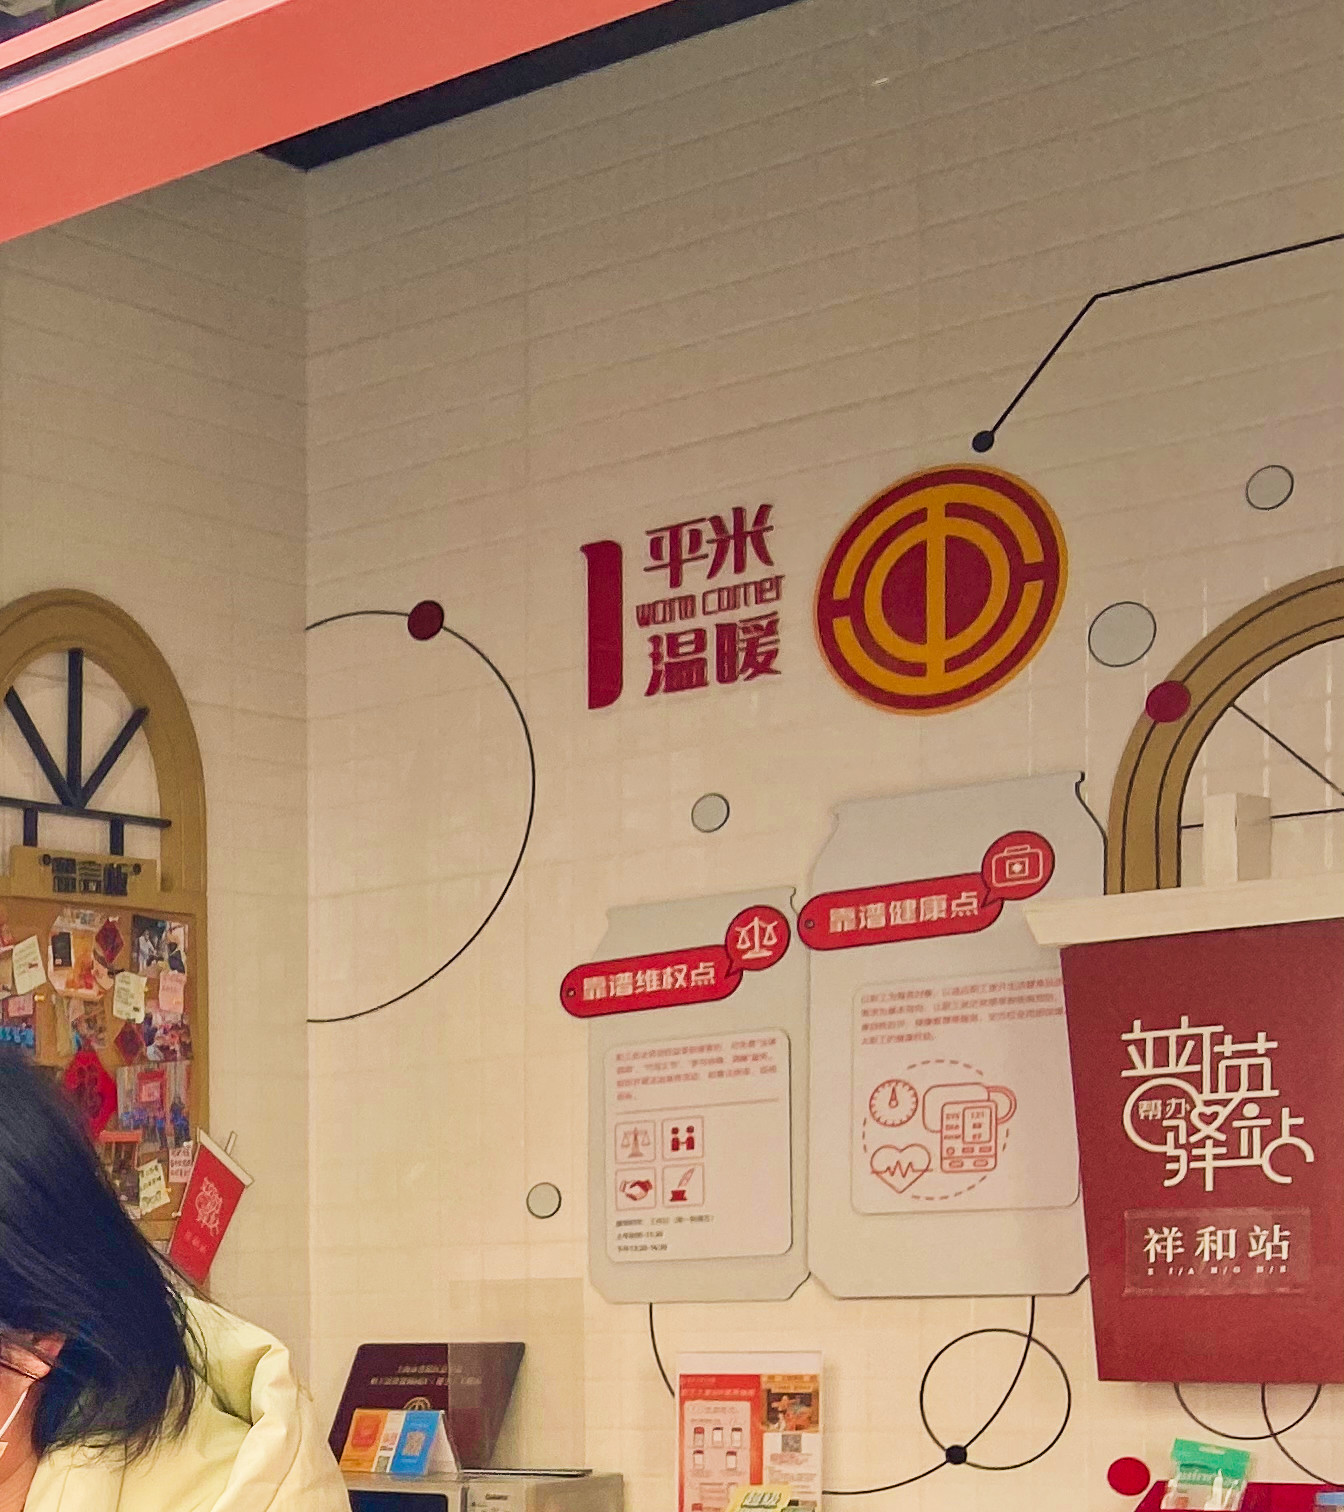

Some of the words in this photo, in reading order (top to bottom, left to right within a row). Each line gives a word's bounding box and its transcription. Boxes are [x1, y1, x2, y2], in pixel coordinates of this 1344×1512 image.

[644, 504, 773, 588] 平米
[644, 611, 782, 697] 温暖
[829, 891, 978, 934] 靠谱健康点
[583, 961, 715, 1001] 靠谱维权点
[1138, 1098, 1191, 1121] 帮办
[1143, 1224, 1291, 1263] 祥和站
